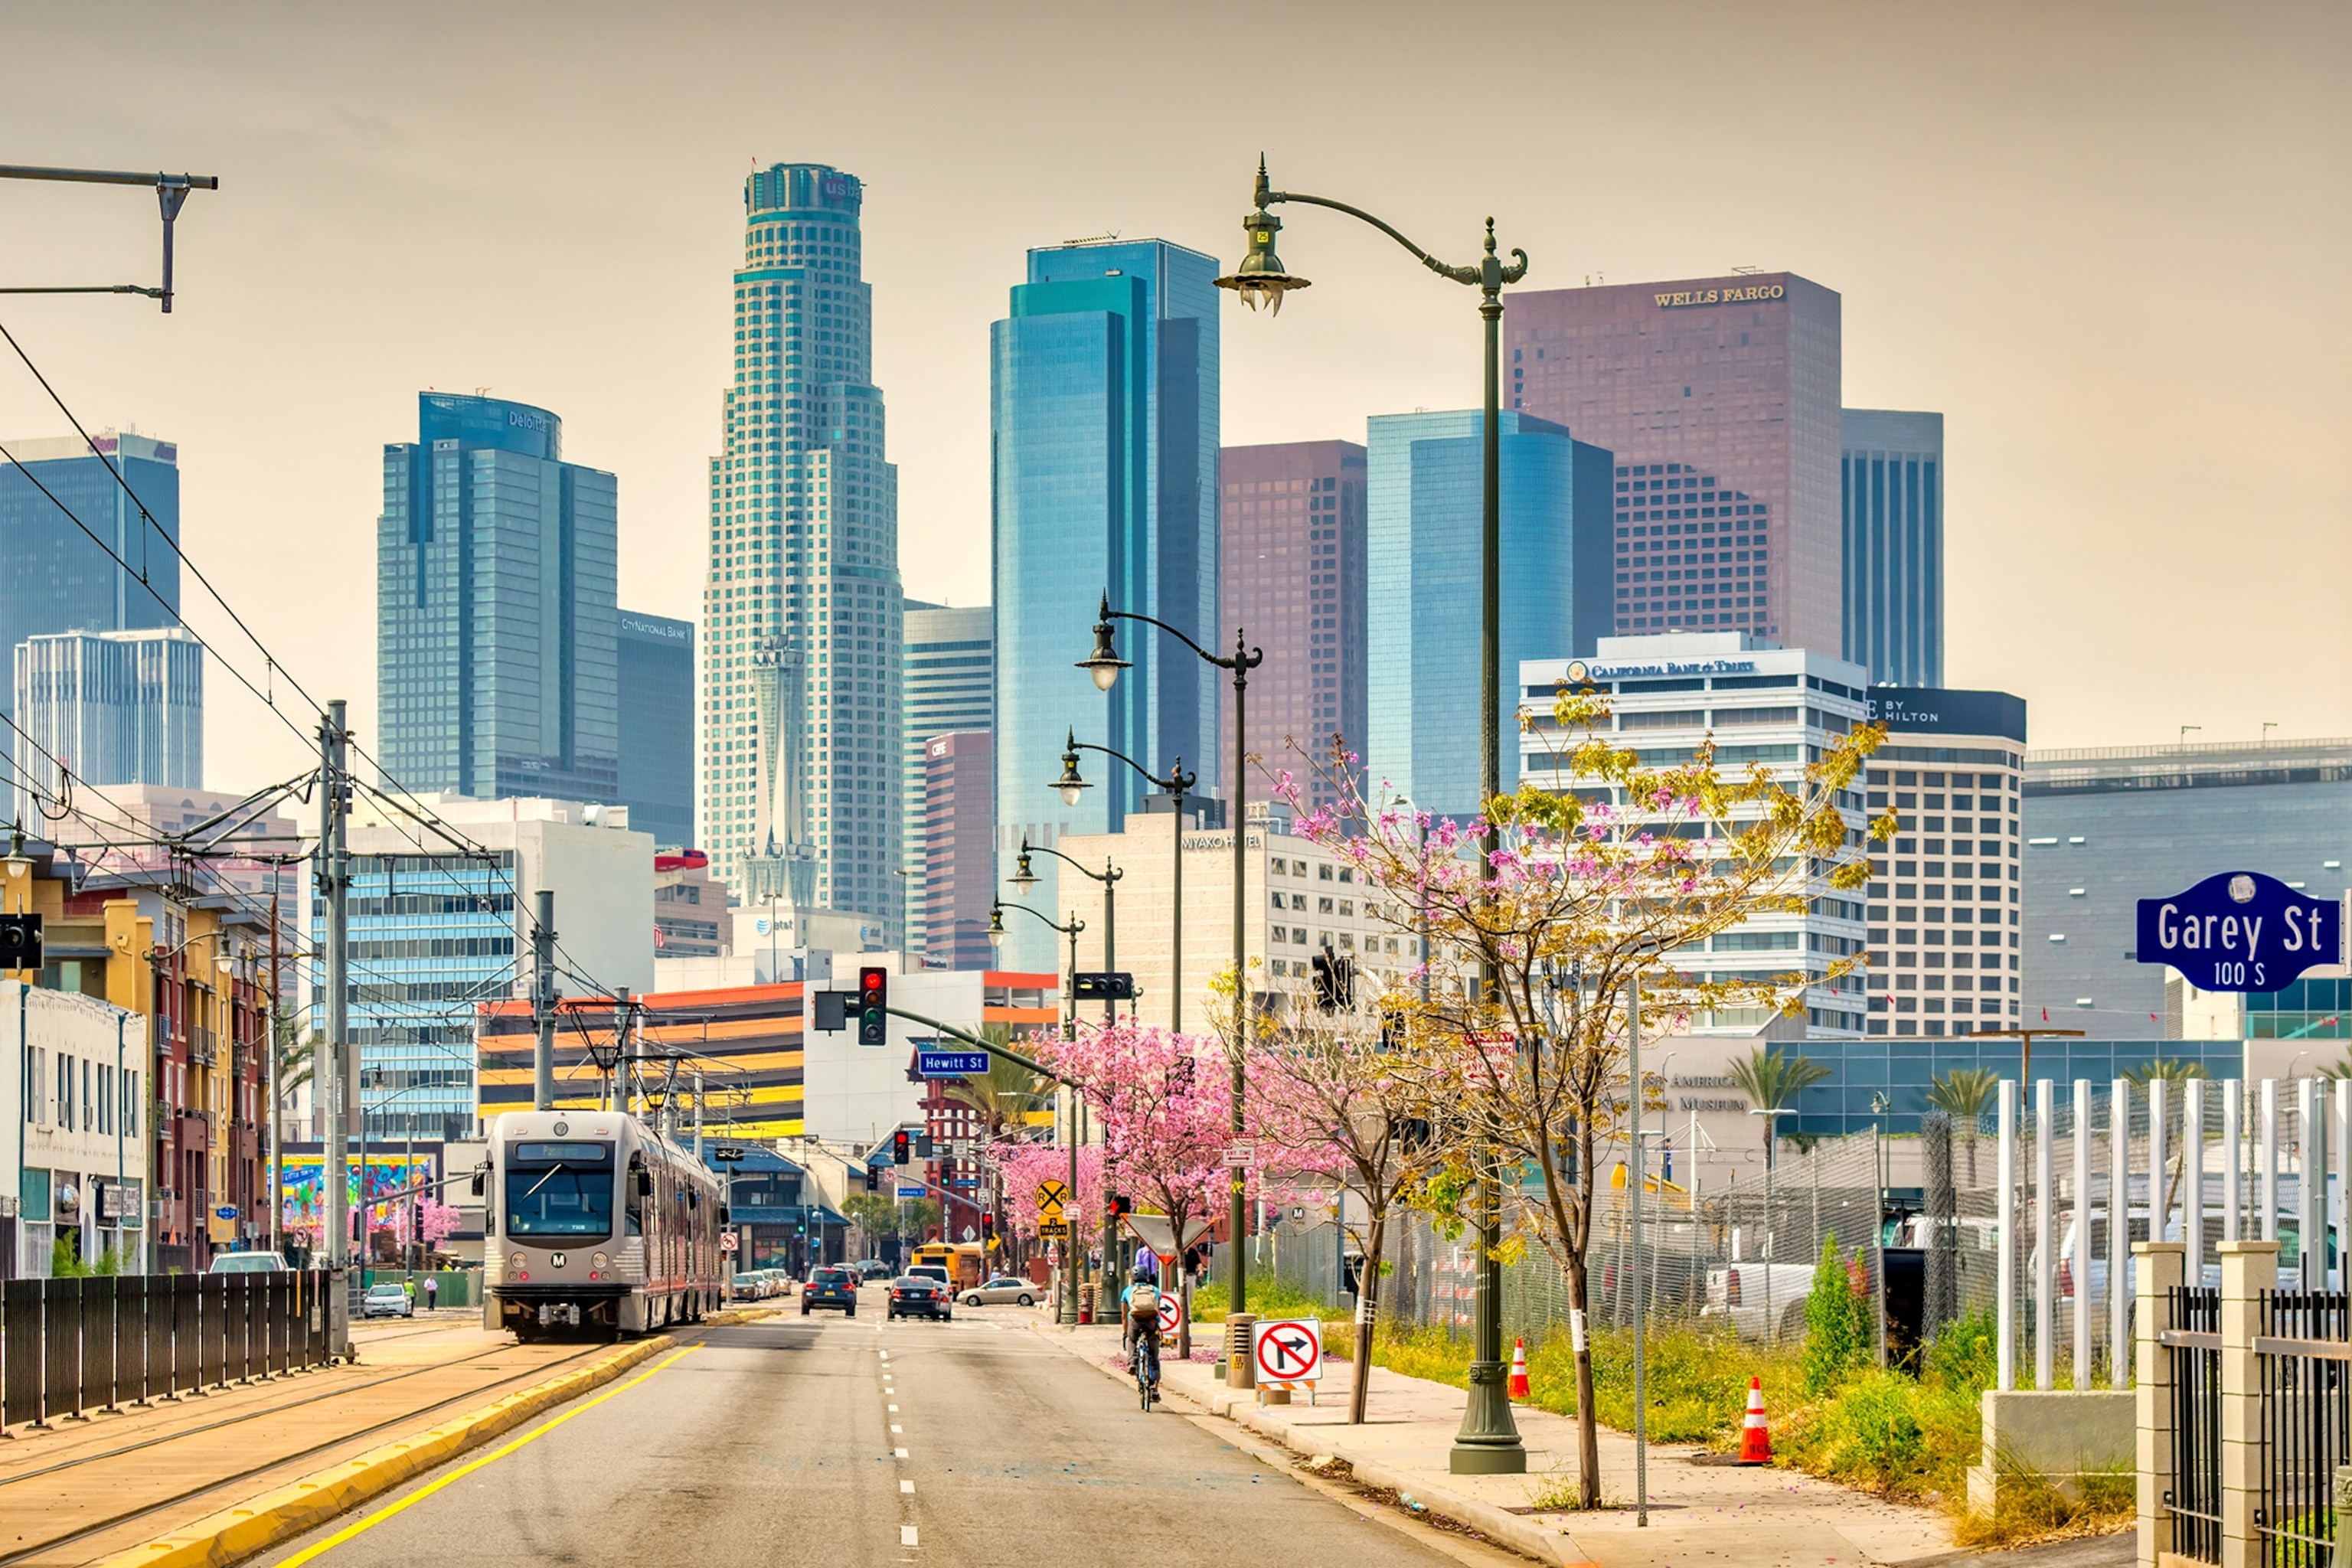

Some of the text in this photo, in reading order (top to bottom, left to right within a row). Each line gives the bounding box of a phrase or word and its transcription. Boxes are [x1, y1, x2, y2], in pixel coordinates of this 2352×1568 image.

[1654, 285, 1784, 307] WELLS FARGO
[508, 410, 546, 433] Deloitte
[668, 626, 685, 639] BANK
[1592, 665, 1662, 678] CALIFORNIA
[1667, 662, 1699, 675] BANK
[1714, 661, 1754, 673] TRUST
[1886, 701, 1903, 710] BY
[1886, 712, 1939, 722] HILTON
[1181, 834, 1260, 848] MIYAKO HTEL
[2158, 903, 2322, 962] Garey St
[2214, 962, 2265, 985] 100 S
[926, 1057, 982, 1069] Hewitt St
[1670, 1073, 1740, 1087] AMERICA
[1681, 1096, 1747, 1111] MUSEUM
[1038, 1193, 1067, 1201] R R
[1294, 1208, 1302, 1217] M
[553, 1254, 565, 1266] M
